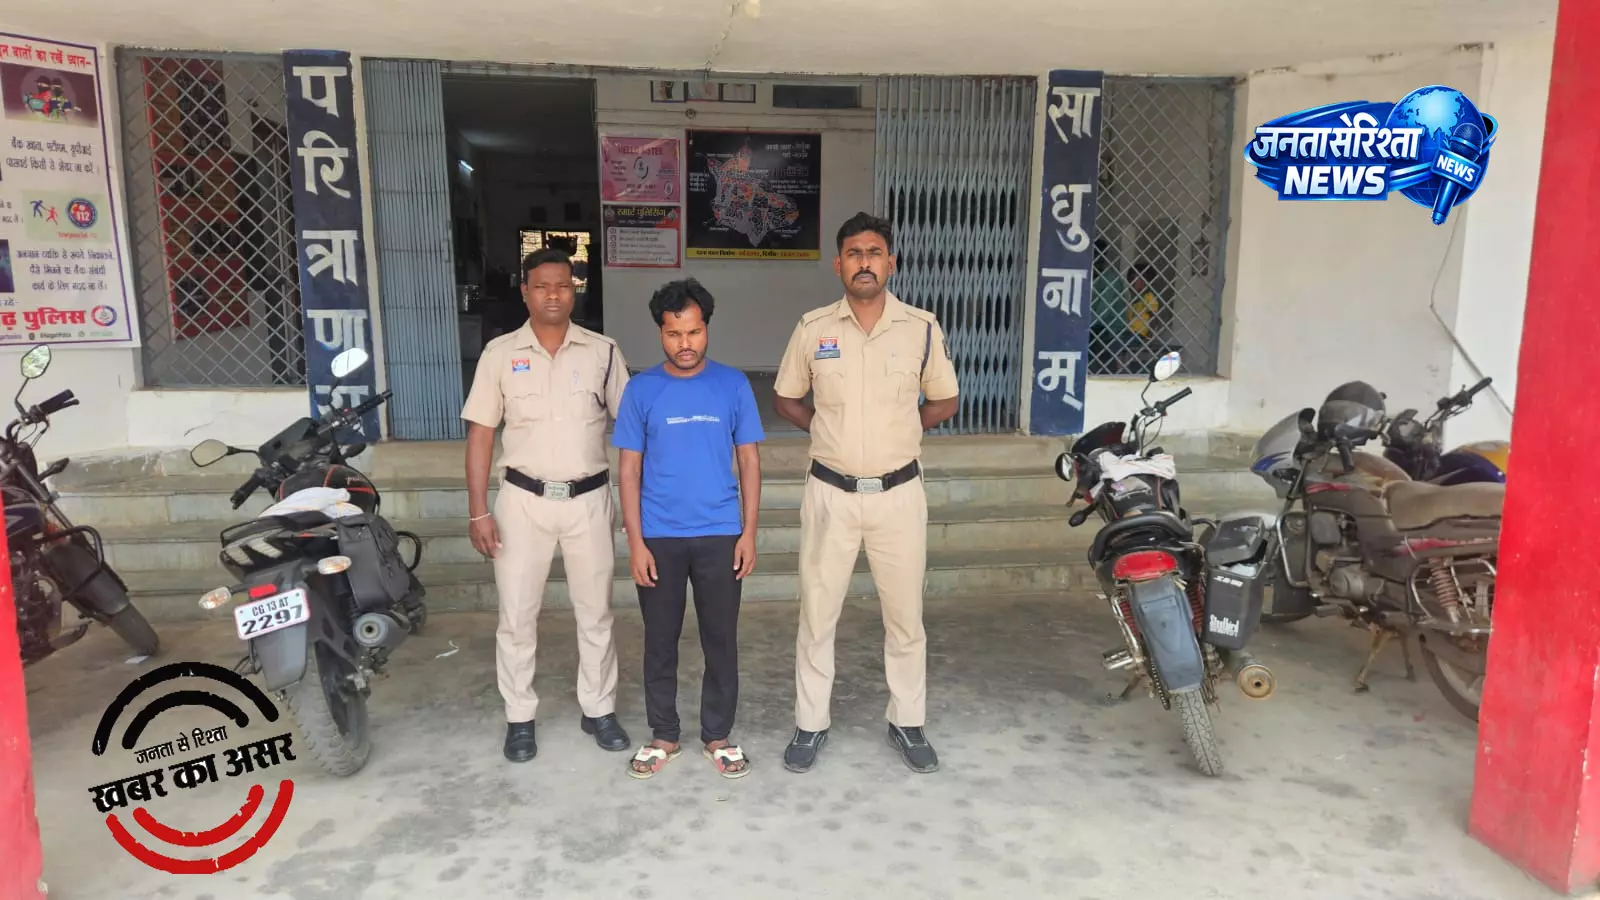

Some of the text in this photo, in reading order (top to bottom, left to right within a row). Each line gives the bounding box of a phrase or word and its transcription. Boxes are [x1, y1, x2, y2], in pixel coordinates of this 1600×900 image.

[36, 49, 47, 63] का
[76, 211, 90, 222] 112
[0, 306, 87, 331] ढ़ पुलिस
[252, 596, 289, 617] CG 13 AT
[242, 605, 302, 635] 2297
